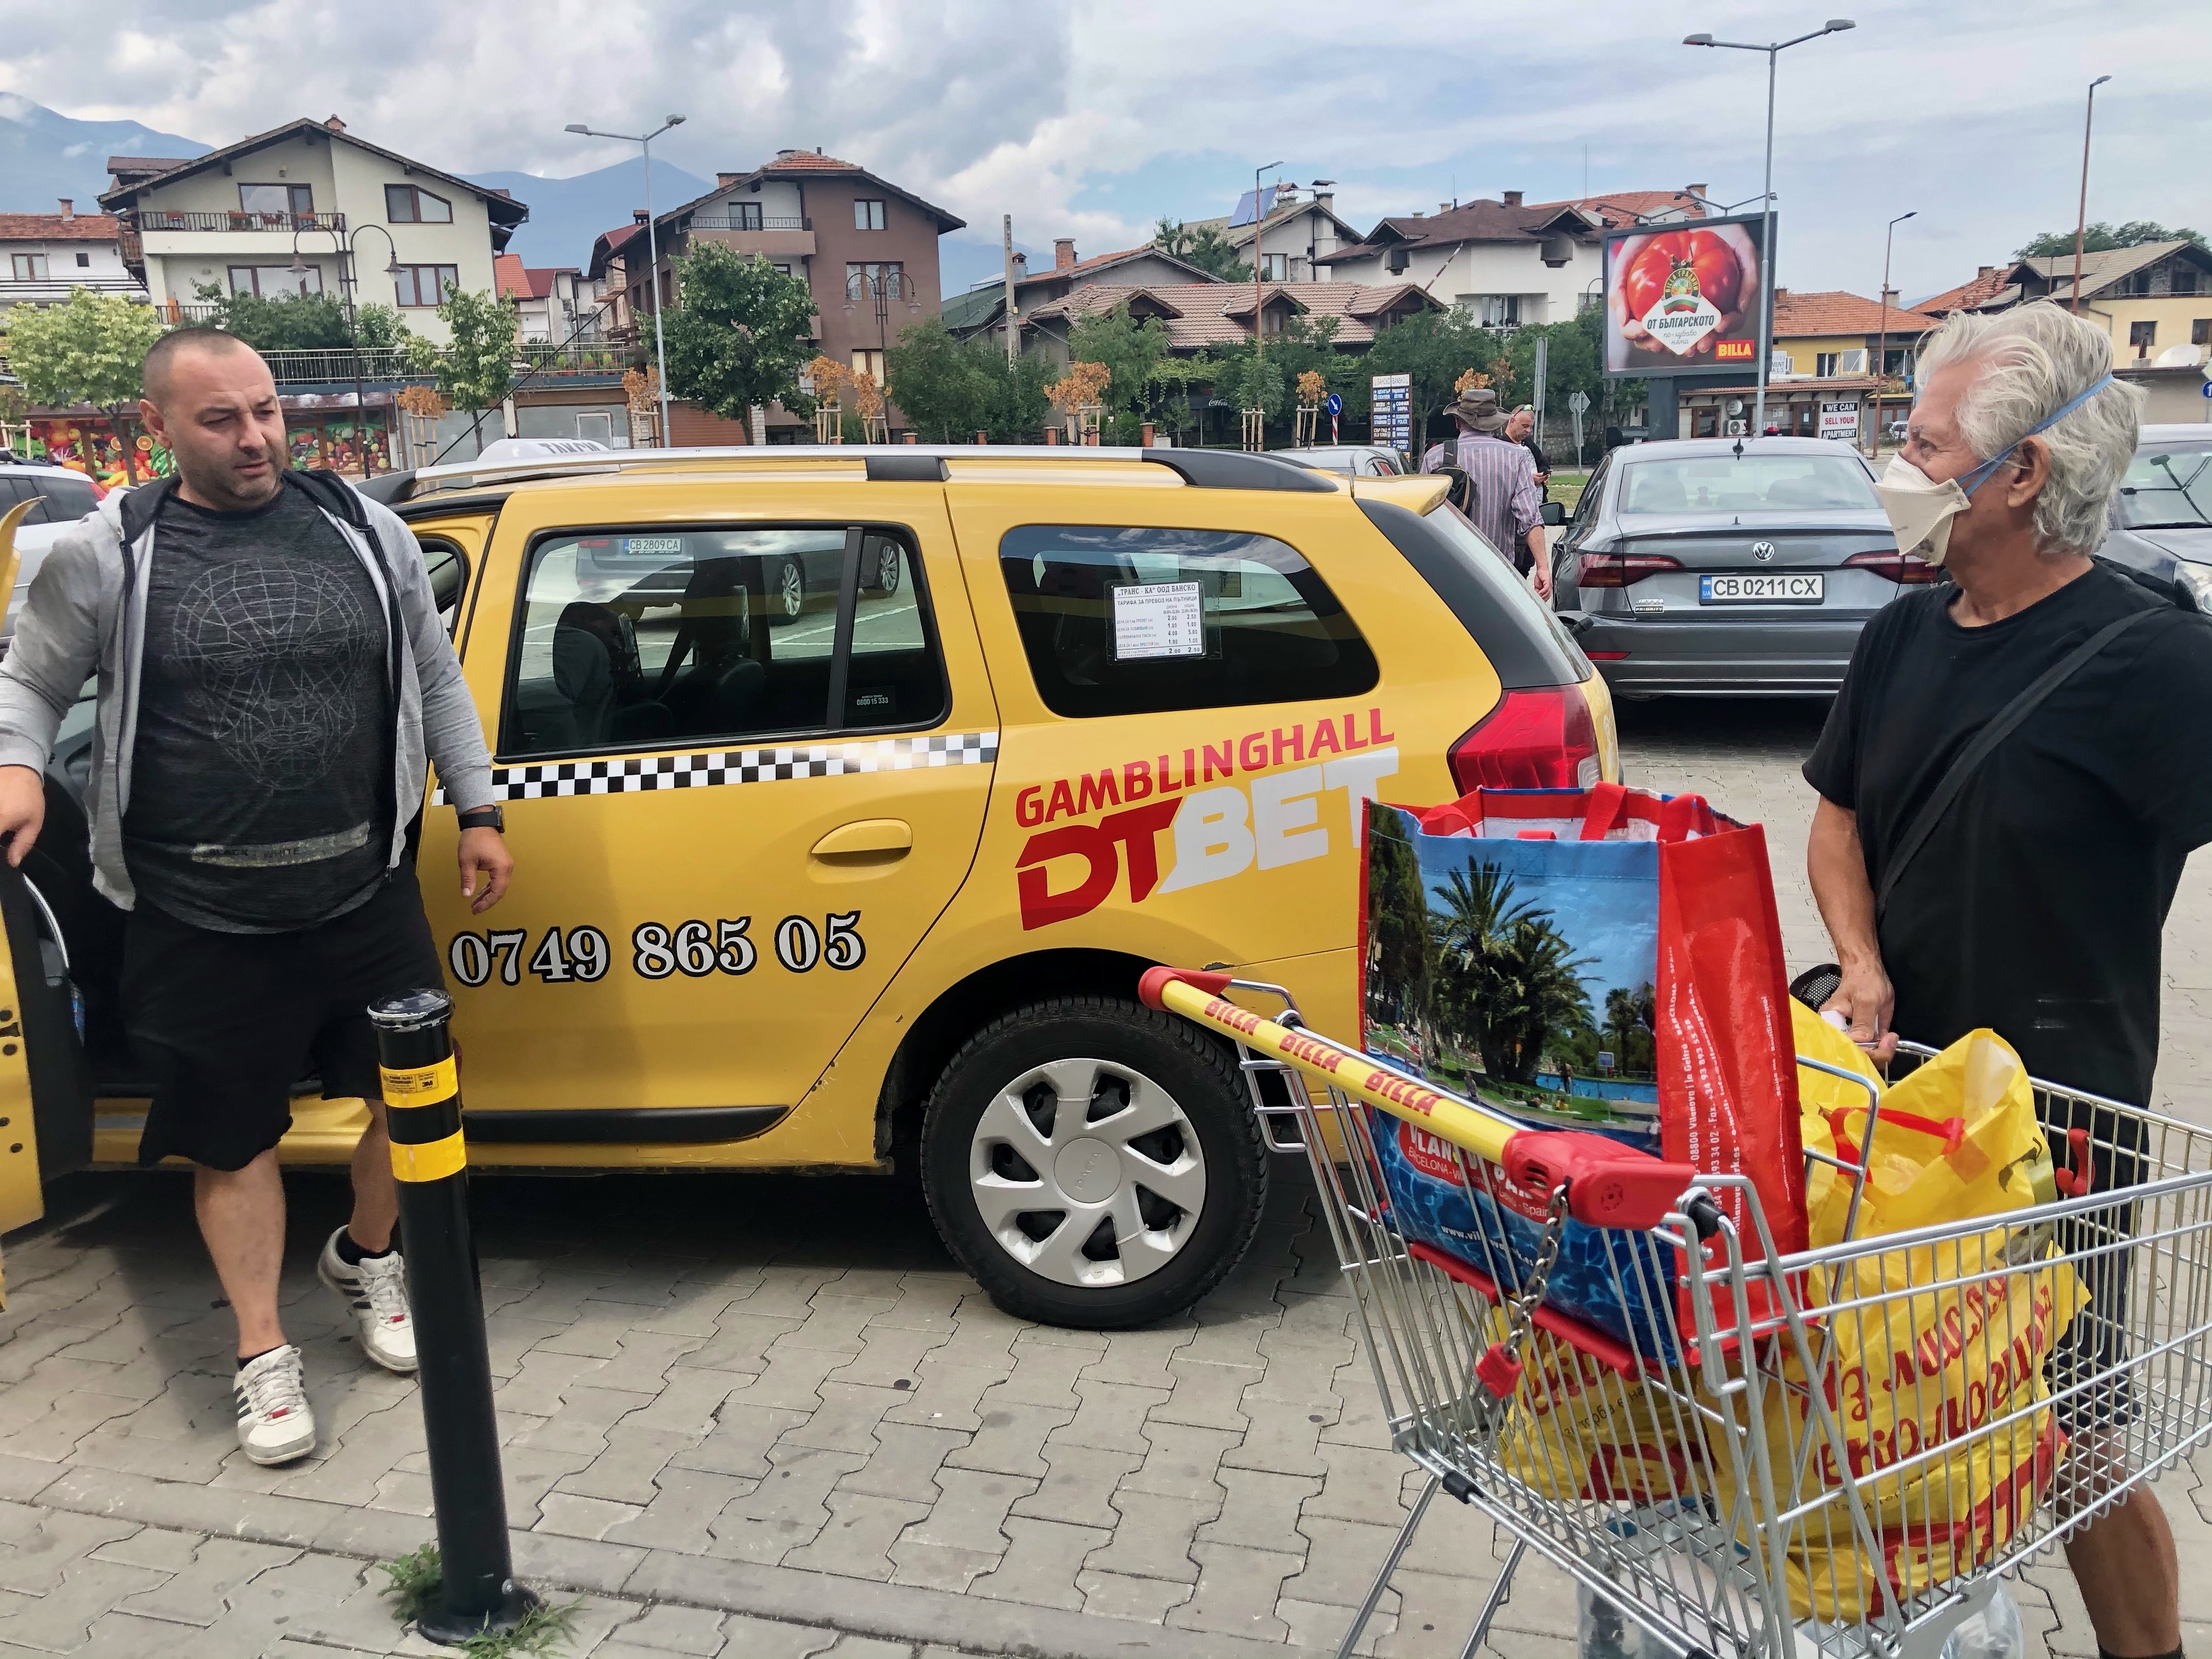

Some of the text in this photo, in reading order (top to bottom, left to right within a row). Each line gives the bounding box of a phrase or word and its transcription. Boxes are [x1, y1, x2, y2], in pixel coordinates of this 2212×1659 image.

[1647, 315, 1714, 330] ОТ БЪЛГАРСКОТО
[1718, 343, 1752, 357] BILLA
[1839, 403, 1855, 411] CAN
[1822, 429, 1856, 439] APARTMENT
[630, 540, 679, 550] CB 2809 CA
[1171, 584, 1196, 592] БАНСКО
[1714, 578, 1817, 596] CB 0211 CX
[1015, 708, 1395, 828] GAMBLINGHALL
[448, 910, 867, 988] 0749 865 05
[1669, 983, 1683, 1035] BARCELONA
[1691, 1033, 1700, 1045] 55
[1205, 999, 1443, 1117] BILLA BILLA BILLA
[1695, 1047, 1706, 1065] 893
[1700, 1068, 1708, 1080] 93
[1703, 1083, 1714, 1100] +34
[1688, 1091, 1697, 1129] Vilanova
[1709, 1132, 1719, 1143] 02
[1690, 1132, 1700, 1160] 08800
[1711, 1147, 1720, 1156] 34
